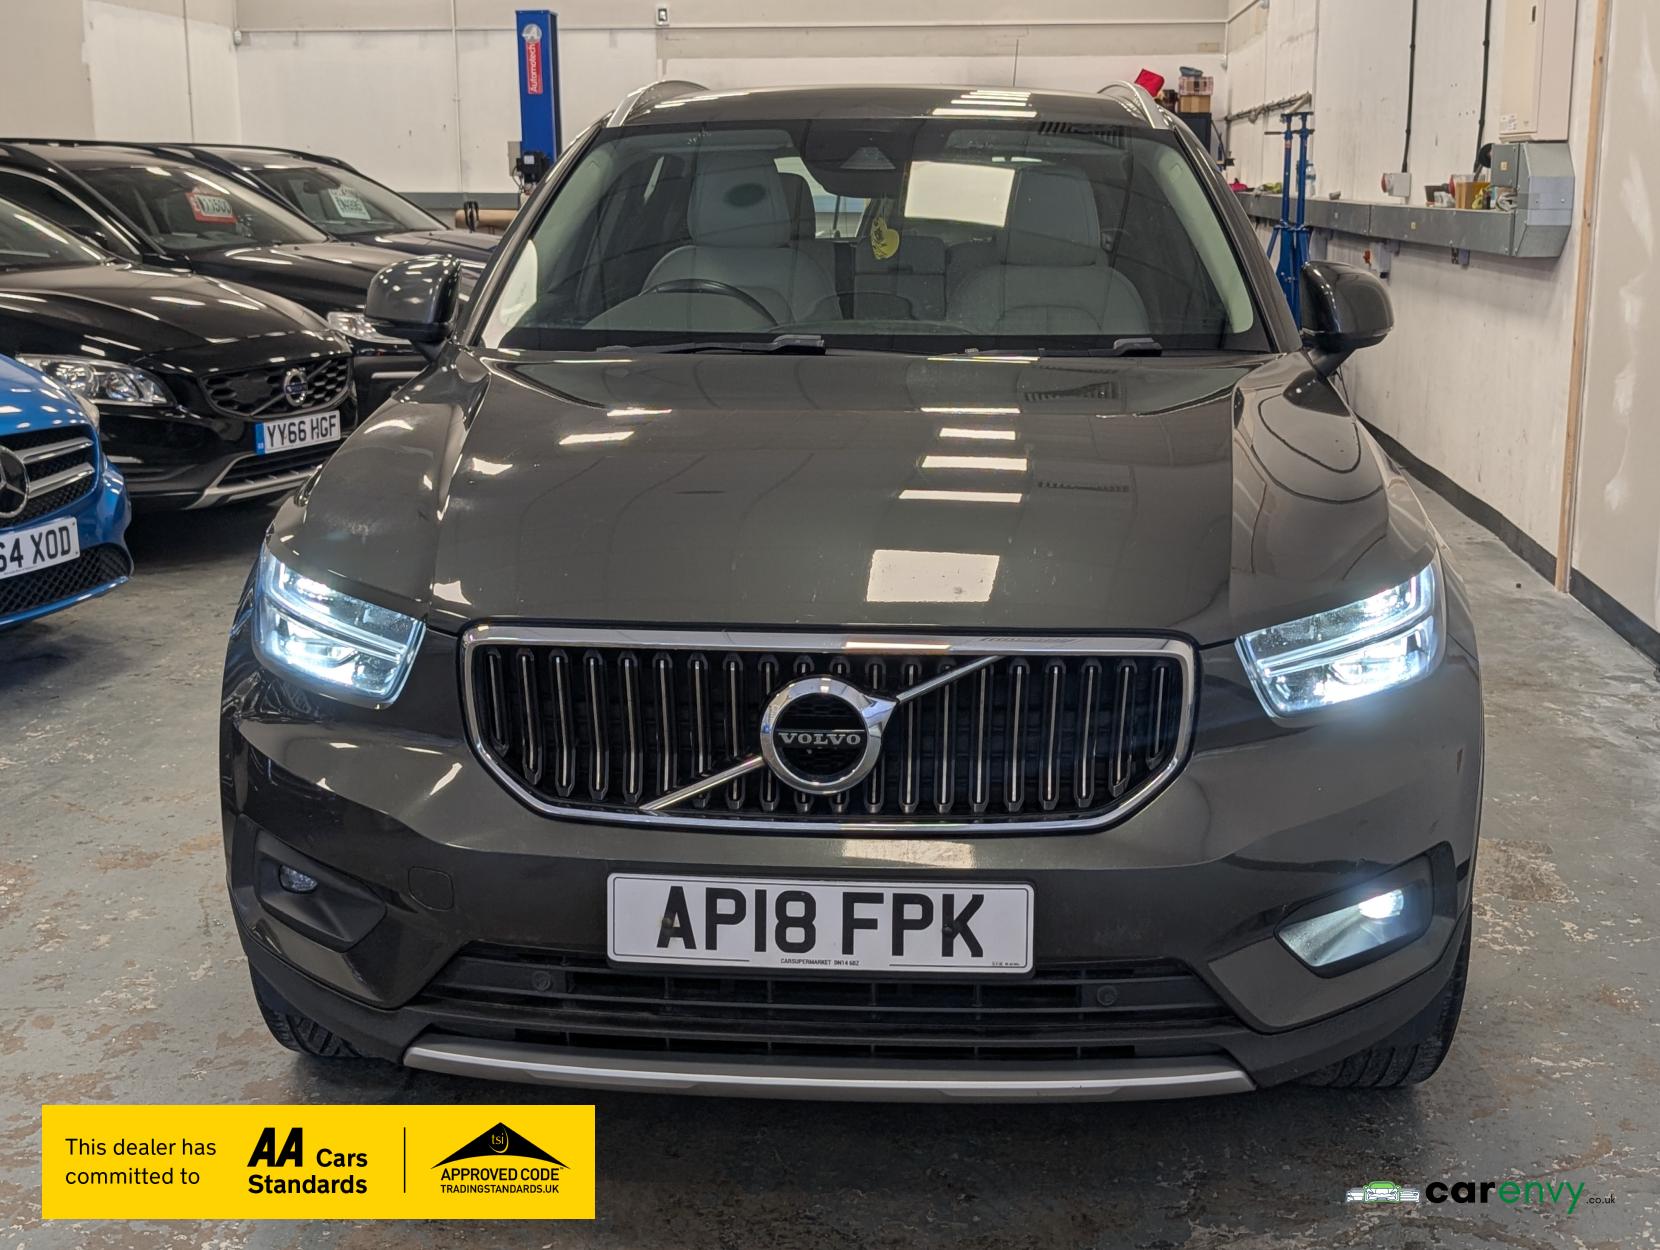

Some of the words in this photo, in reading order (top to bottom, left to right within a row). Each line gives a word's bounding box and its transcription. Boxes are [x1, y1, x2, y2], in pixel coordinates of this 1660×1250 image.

[528, 43, 538, 93] Automotech
[267, 421, 307, 448] YY66
[311, 415, 337, 440] HGF
[30, 526, 71, 565] XOD
[778, 732, 861, 745] VOLVO
[656, 885, 816, 954] AP18
[842, 892, 985, 958] FPK
